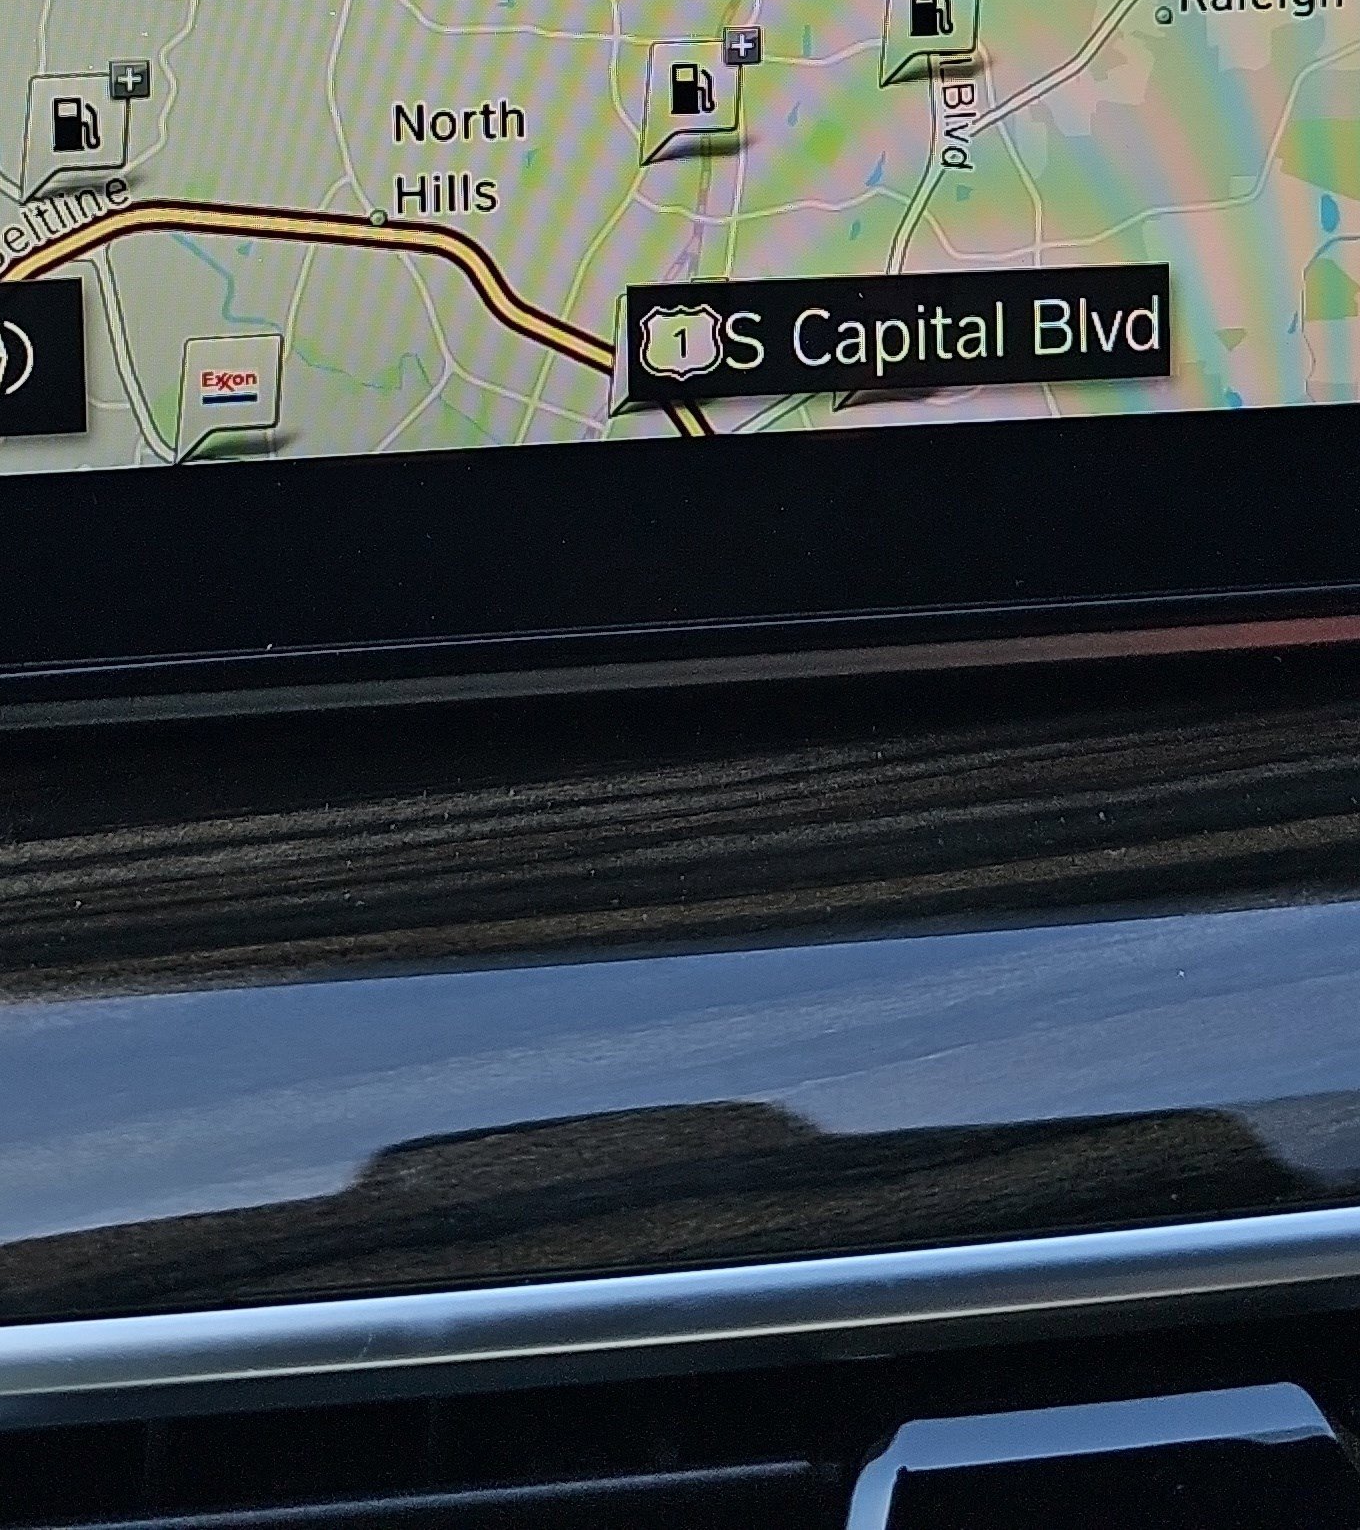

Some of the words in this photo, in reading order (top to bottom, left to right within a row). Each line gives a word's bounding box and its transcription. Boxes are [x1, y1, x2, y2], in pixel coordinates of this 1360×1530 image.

[392, 99, 526, 142] North
[941, 82, 977, 171] Blvd
[397, 174, 498, 214] Hills
[673, 327, 688, 359] 1
[725, 311, 765, 370] S
[792, 301, 1004, 377] Capital
[1034, 294, 1161, 356] Blvd
[201, 370, 258, 392] Exxon
